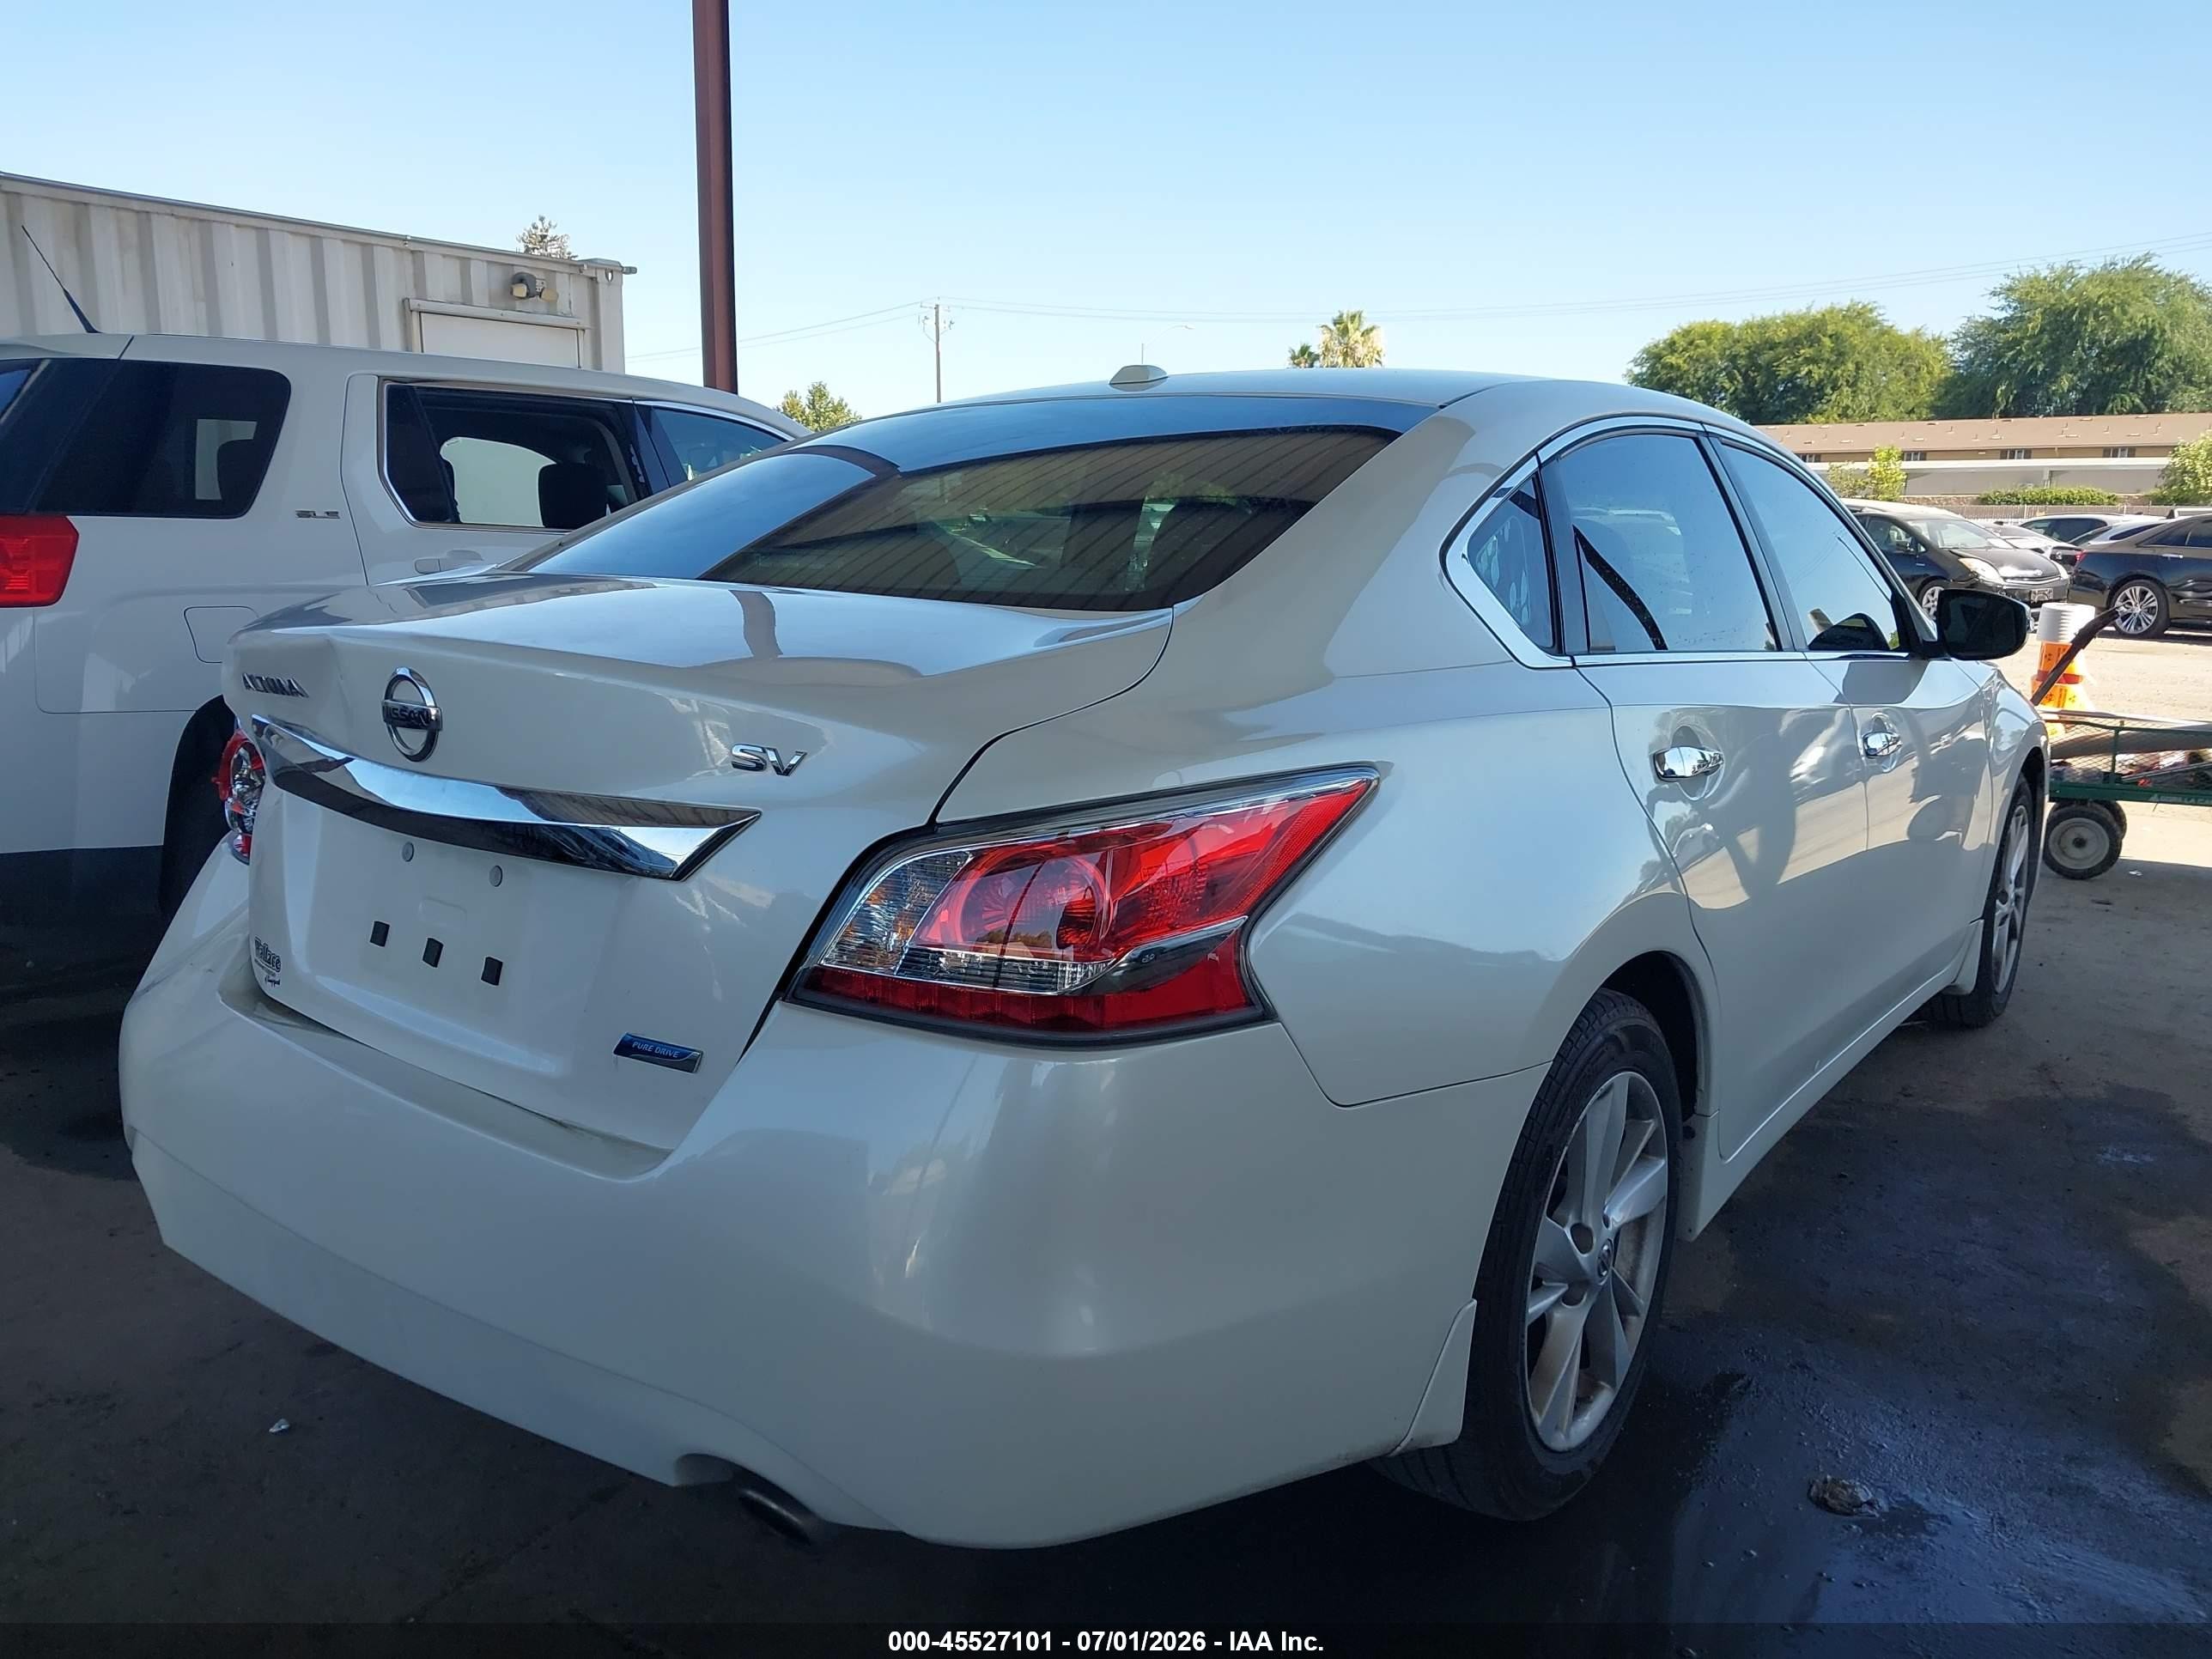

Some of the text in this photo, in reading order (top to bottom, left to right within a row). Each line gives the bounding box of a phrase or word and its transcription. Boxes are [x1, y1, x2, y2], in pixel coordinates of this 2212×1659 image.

[731, 744, 807, 776] SV
[632, 1041, 680, 1058] PURE DRIVE
